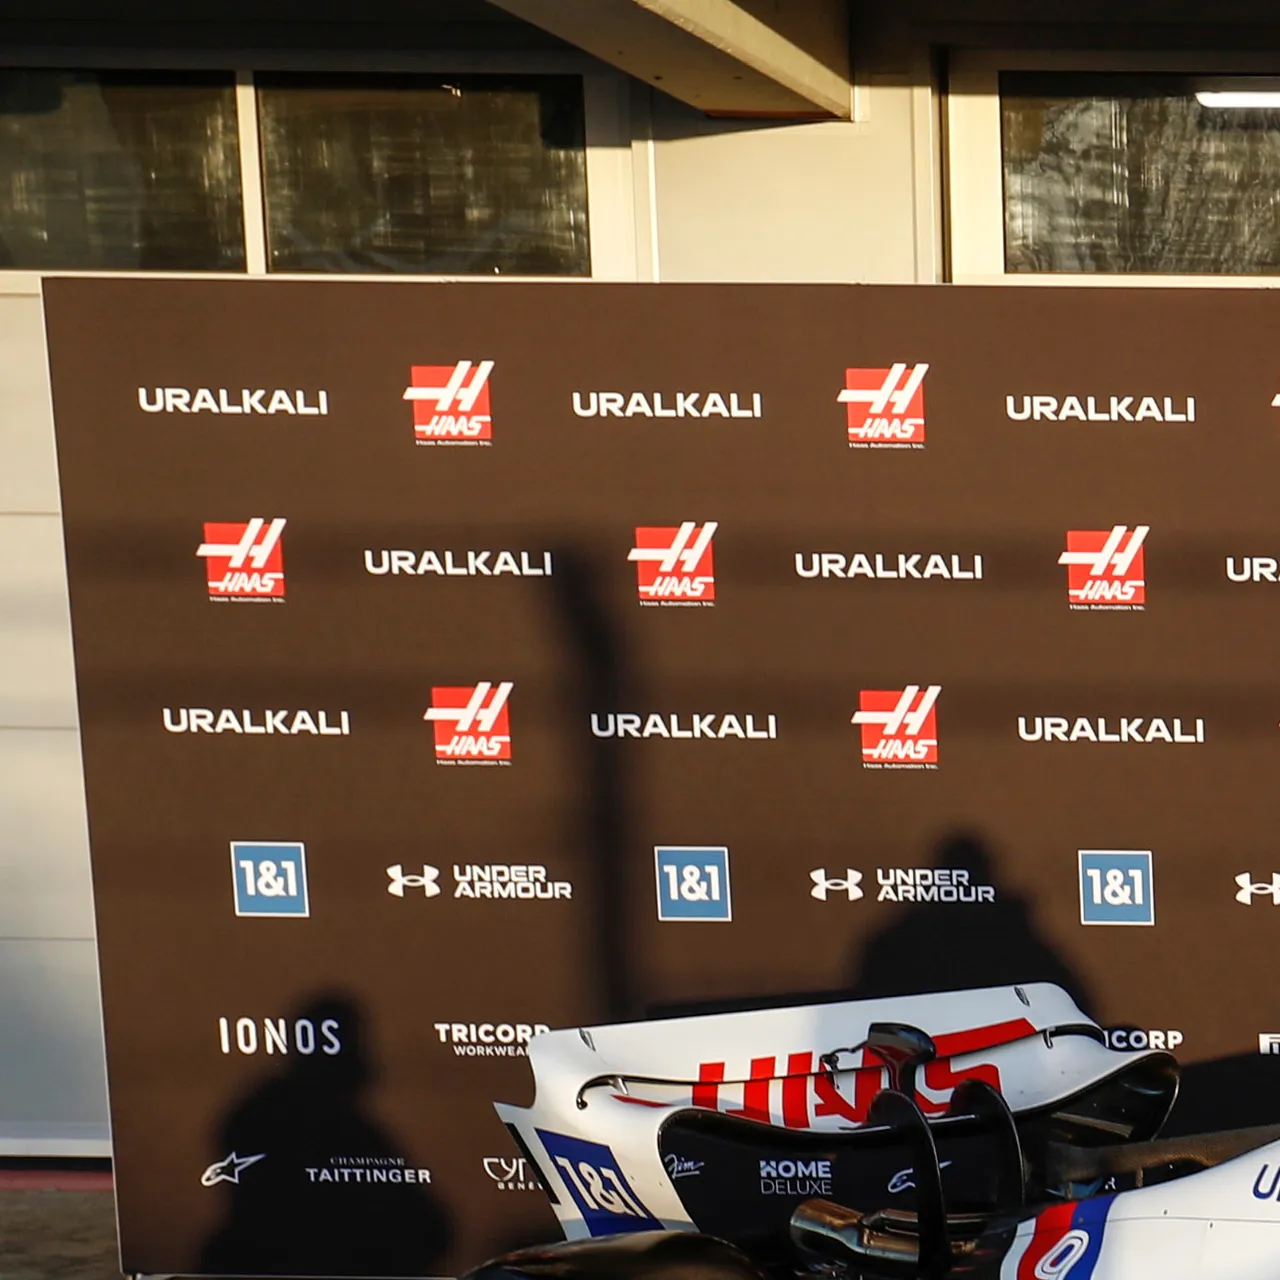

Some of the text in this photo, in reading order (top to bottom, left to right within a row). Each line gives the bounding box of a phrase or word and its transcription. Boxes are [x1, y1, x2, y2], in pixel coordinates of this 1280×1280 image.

[139, 388, 327, 414] URALKALI
[573, 393, 761, 417] URALKALI
[1007, 396, 1194, 421] URALKALI
[415, 415, 491, 435] HAAS
[848, 418, 924, 438] HAAS
[365, 551, 551, 575] URALKALI
[796, 554, 982, 578] URALKALI
[208, 572, 283, 592] HAAS
[639, 576, 714, 596] HAAS
[1069, 580, 1144, 600] HAAS
[163, 709, 349, 734] URALKALI
[592, 714, 776, 738] URALKALI
[1019, 717, 1203, 742] URALKALI
[436, 736, 510, 755] HAAS
[863, 739, 937, 759] HAAS
[239, 858, 299, 897] 1&1
[453, 864, 547, 882] UNDER
[663, 864, 720, 901] 1&1
[876, 868, 970, 885] UNDER
[453, 881, 573, 899] ARMOUR
[876, 885, 995, 902] ARMOUR
[1086, 868, 1143, 905] 1&1
[218, 1016, 341, 1055] IONOS
[330, 1156, 406, 1167] CHAMPAGNE
[760, 1160, 832, 1178] HOME
[305, 1167, 432, 1184] TAITTINGER
[554, 1153, 649, 1221] 1&1
[760, 1179, 833, 1195] DELUXE
